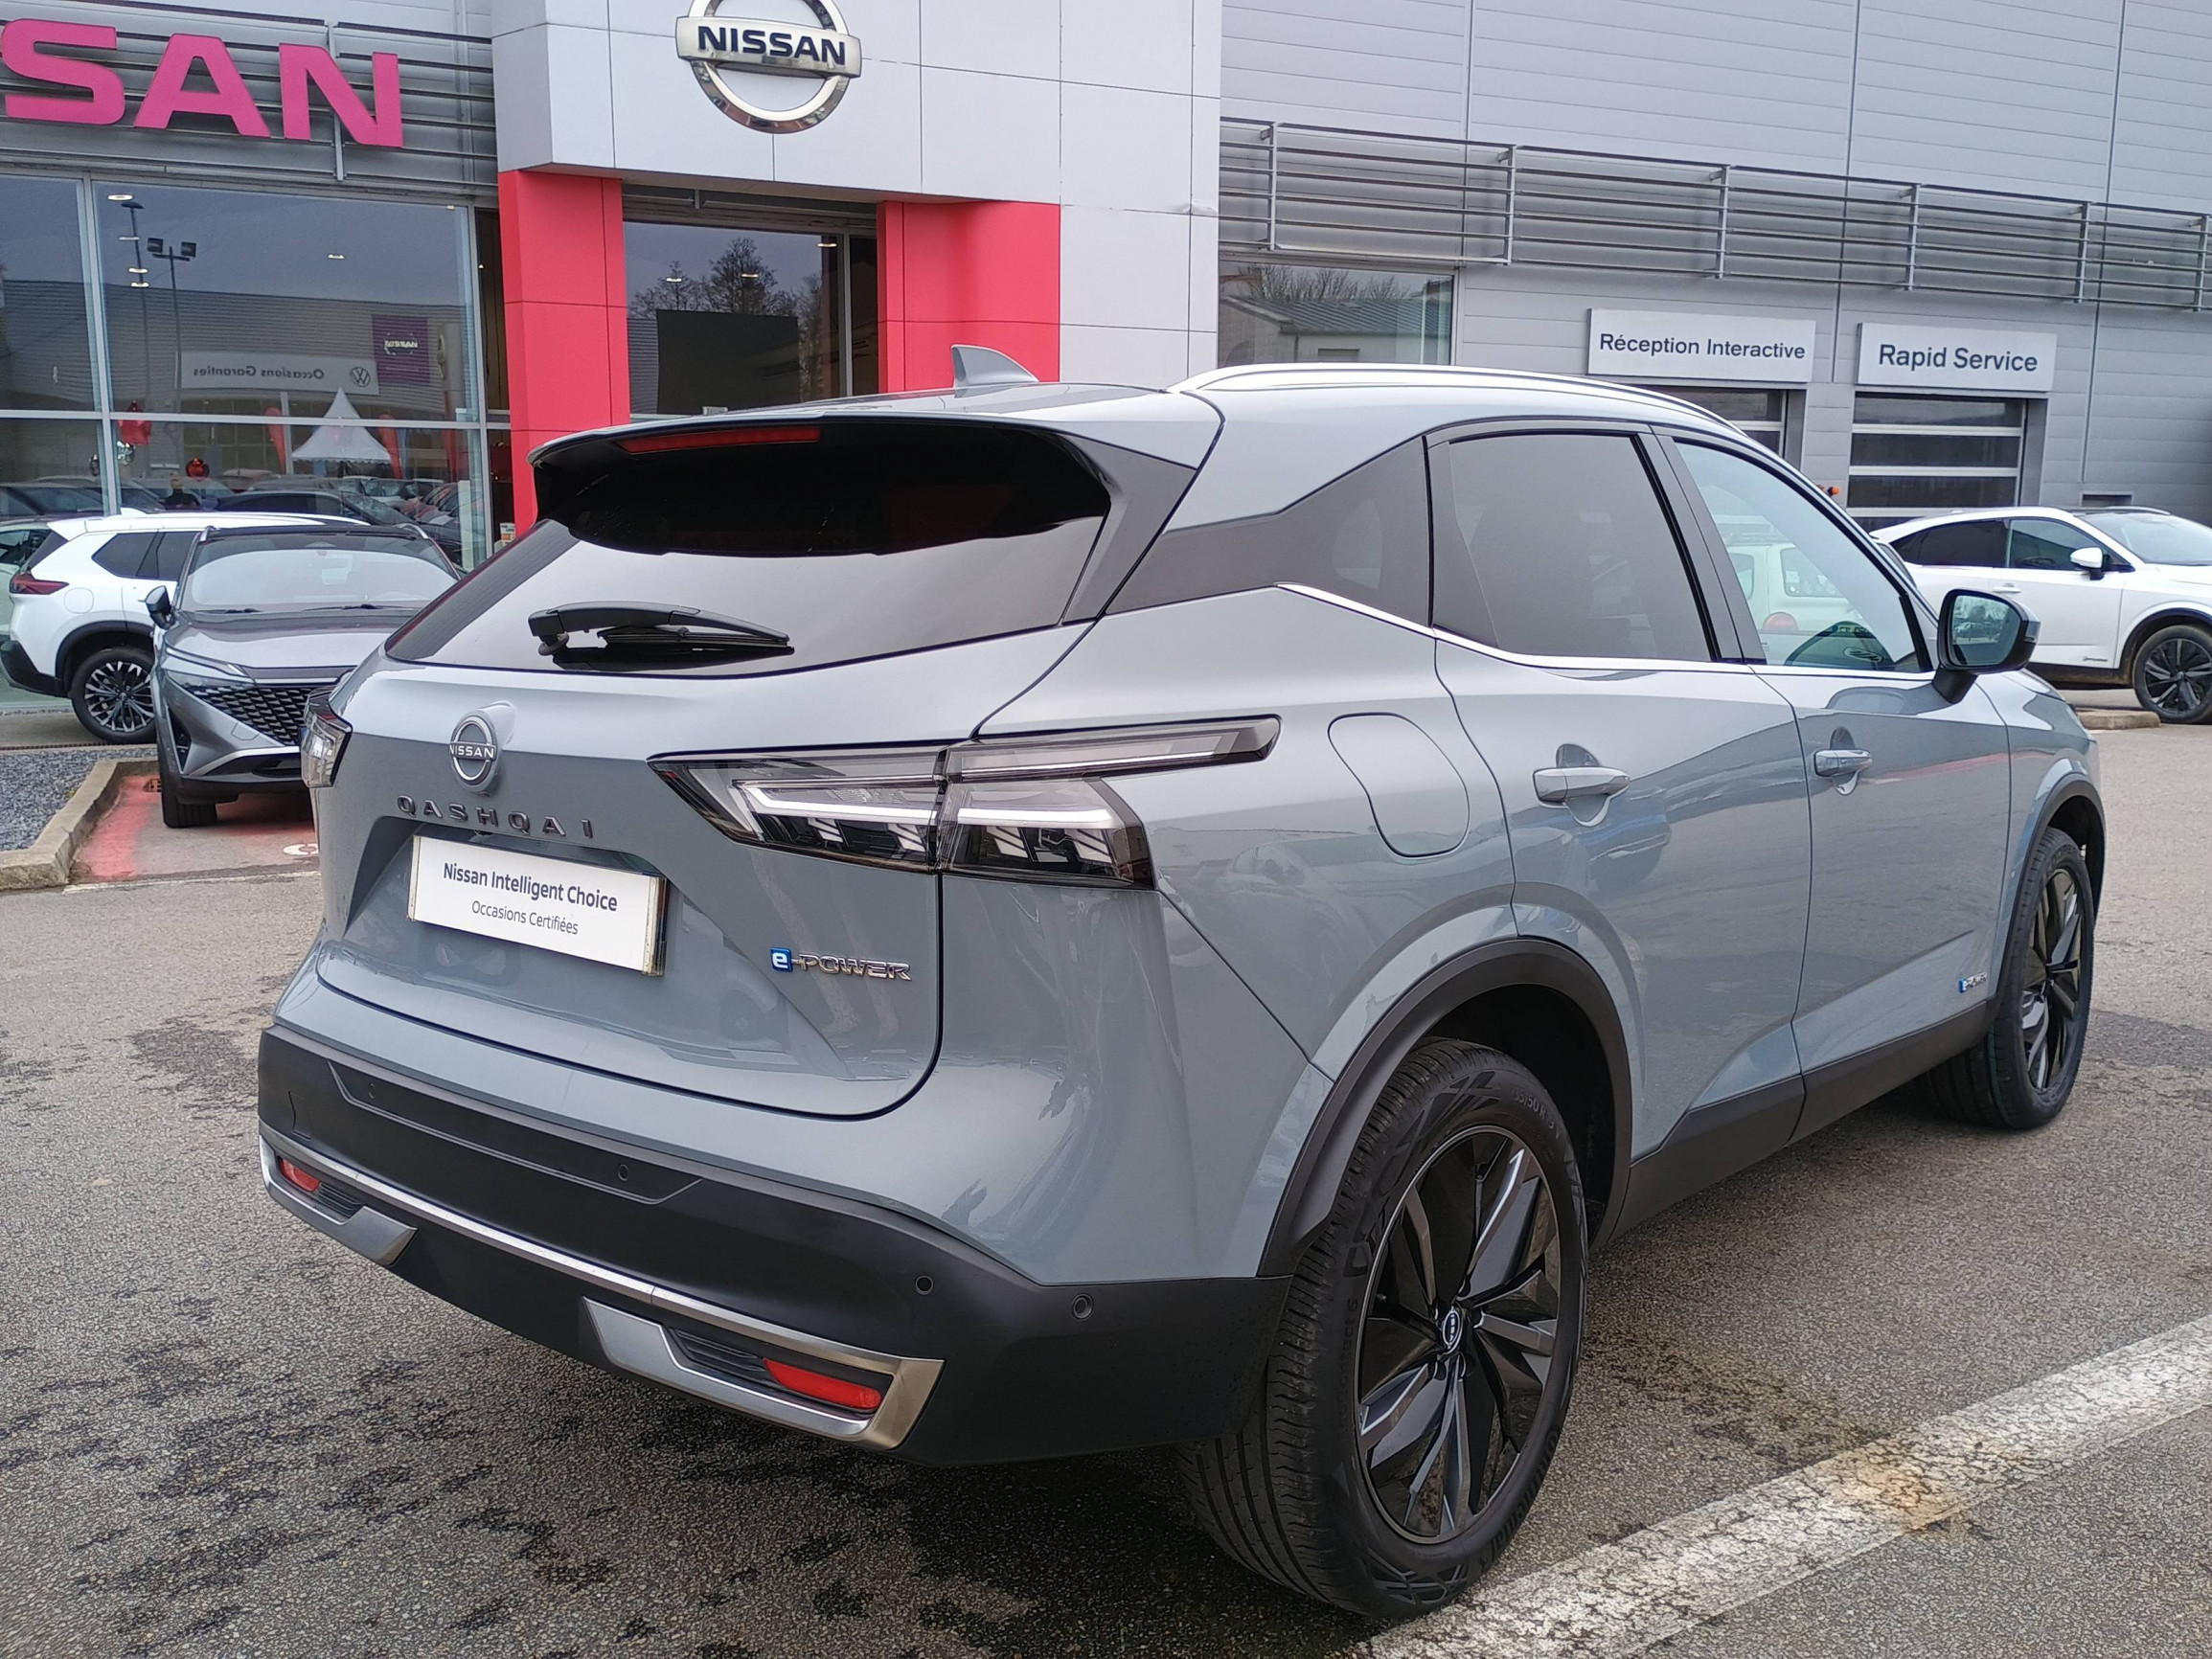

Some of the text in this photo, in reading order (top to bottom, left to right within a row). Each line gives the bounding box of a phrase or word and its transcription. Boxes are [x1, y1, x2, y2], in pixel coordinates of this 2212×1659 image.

[697, 26, 845, 65] NISSAN
[1, 18, 403, 148] SAN
[1600, 333, 1806, 359] Réception Interactive
[1879, 344, 2039, 372] Rapid Service
[449, 744, 494, 758] NISSAN
[398, 795, 594, 838] QASHQAI
[444, 862, 618, 912] Nissan Intelligent Choice
[471, 899, 579, 935] Occasions Certifiées
